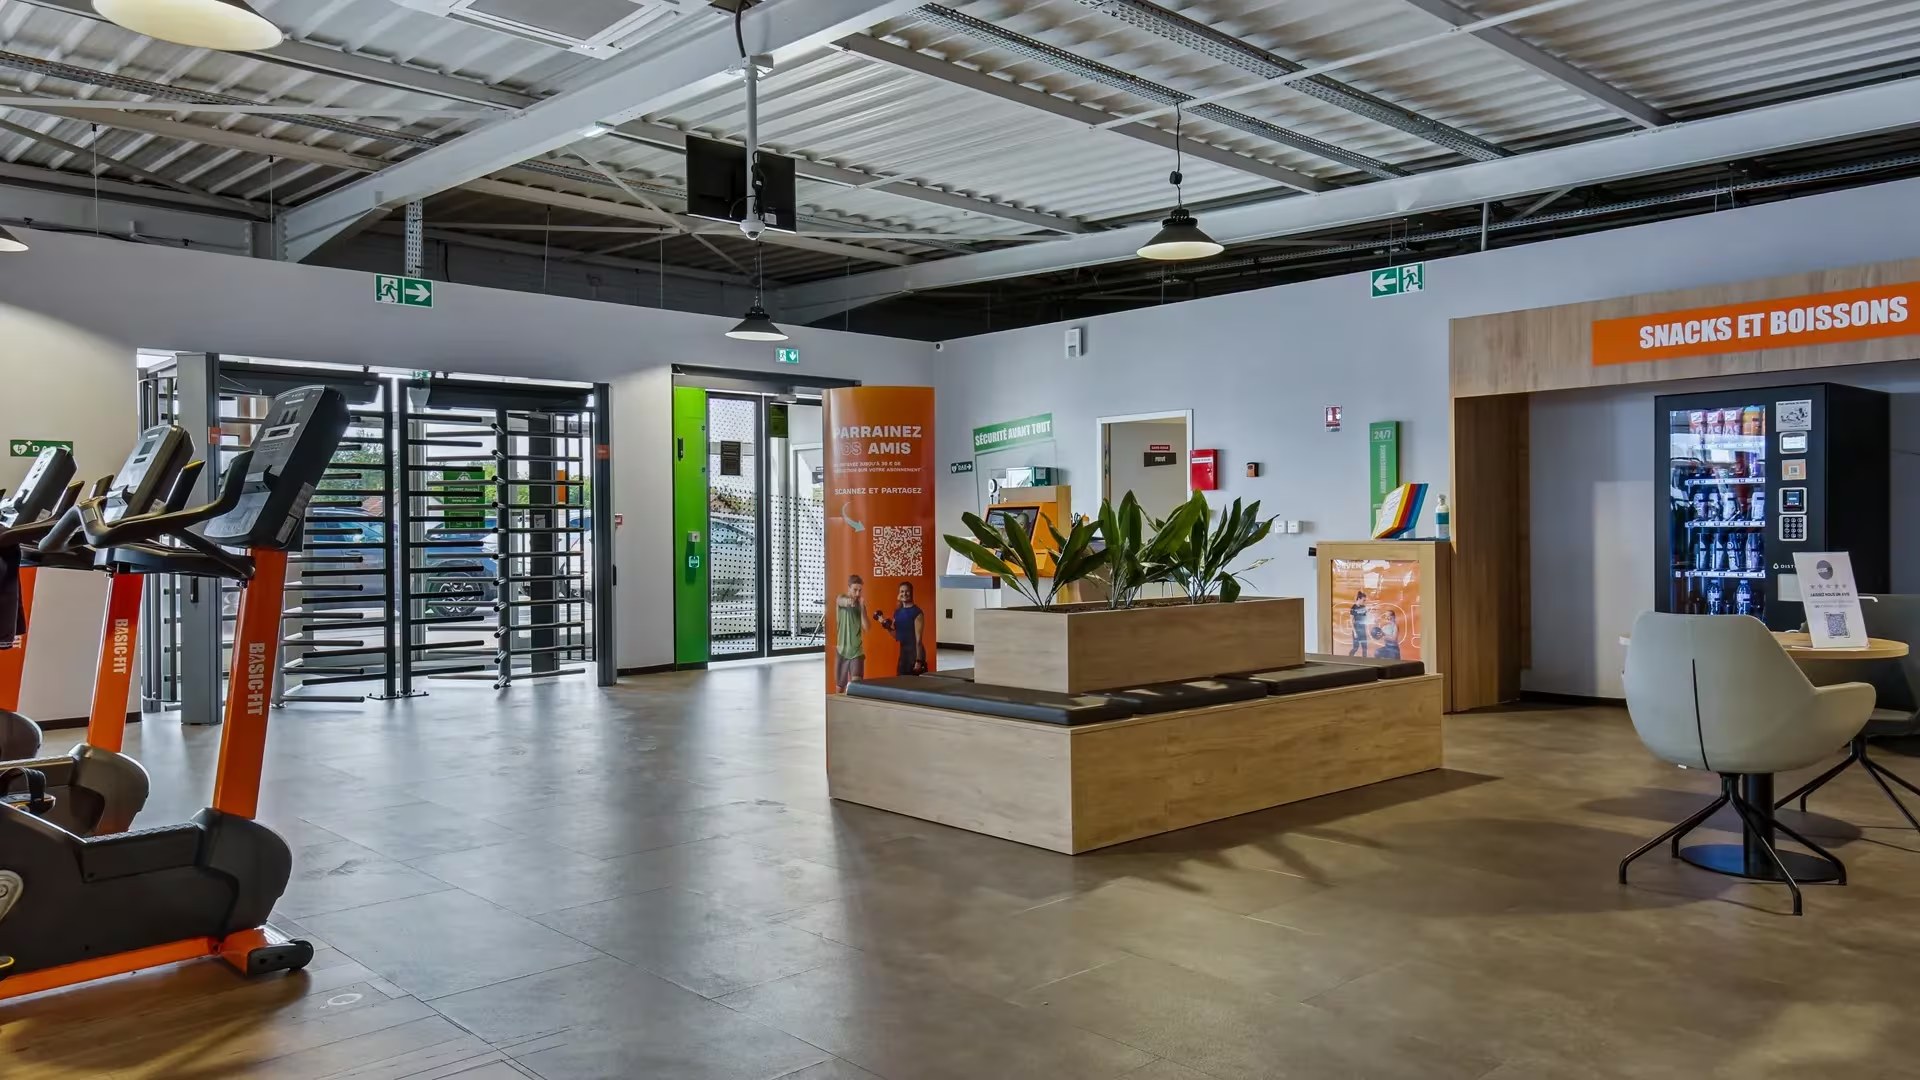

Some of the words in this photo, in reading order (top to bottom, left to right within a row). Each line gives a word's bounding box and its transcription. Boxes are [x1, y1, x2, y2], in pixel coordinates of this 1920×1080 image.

[1639, 315, 1732, 350] SNACKS
[1737, 312, 1765, 339] ET
[1769, 295, 1909, 336] BOISSONS
[833, 425, 922, 439] PARRAINEZ
[974, 427, 1008, 446] SÉCURITÉ
[1008, 424, 1031, 440] AVANT
[1031, 420, 1051, 435] TOUT
[1373, 429, 1391, 440] 24/7
[834, 440, 862, 456] OS
[867, 442, 912, 455] AMIS
[834, 487, 866, 495] SCANNEZ
